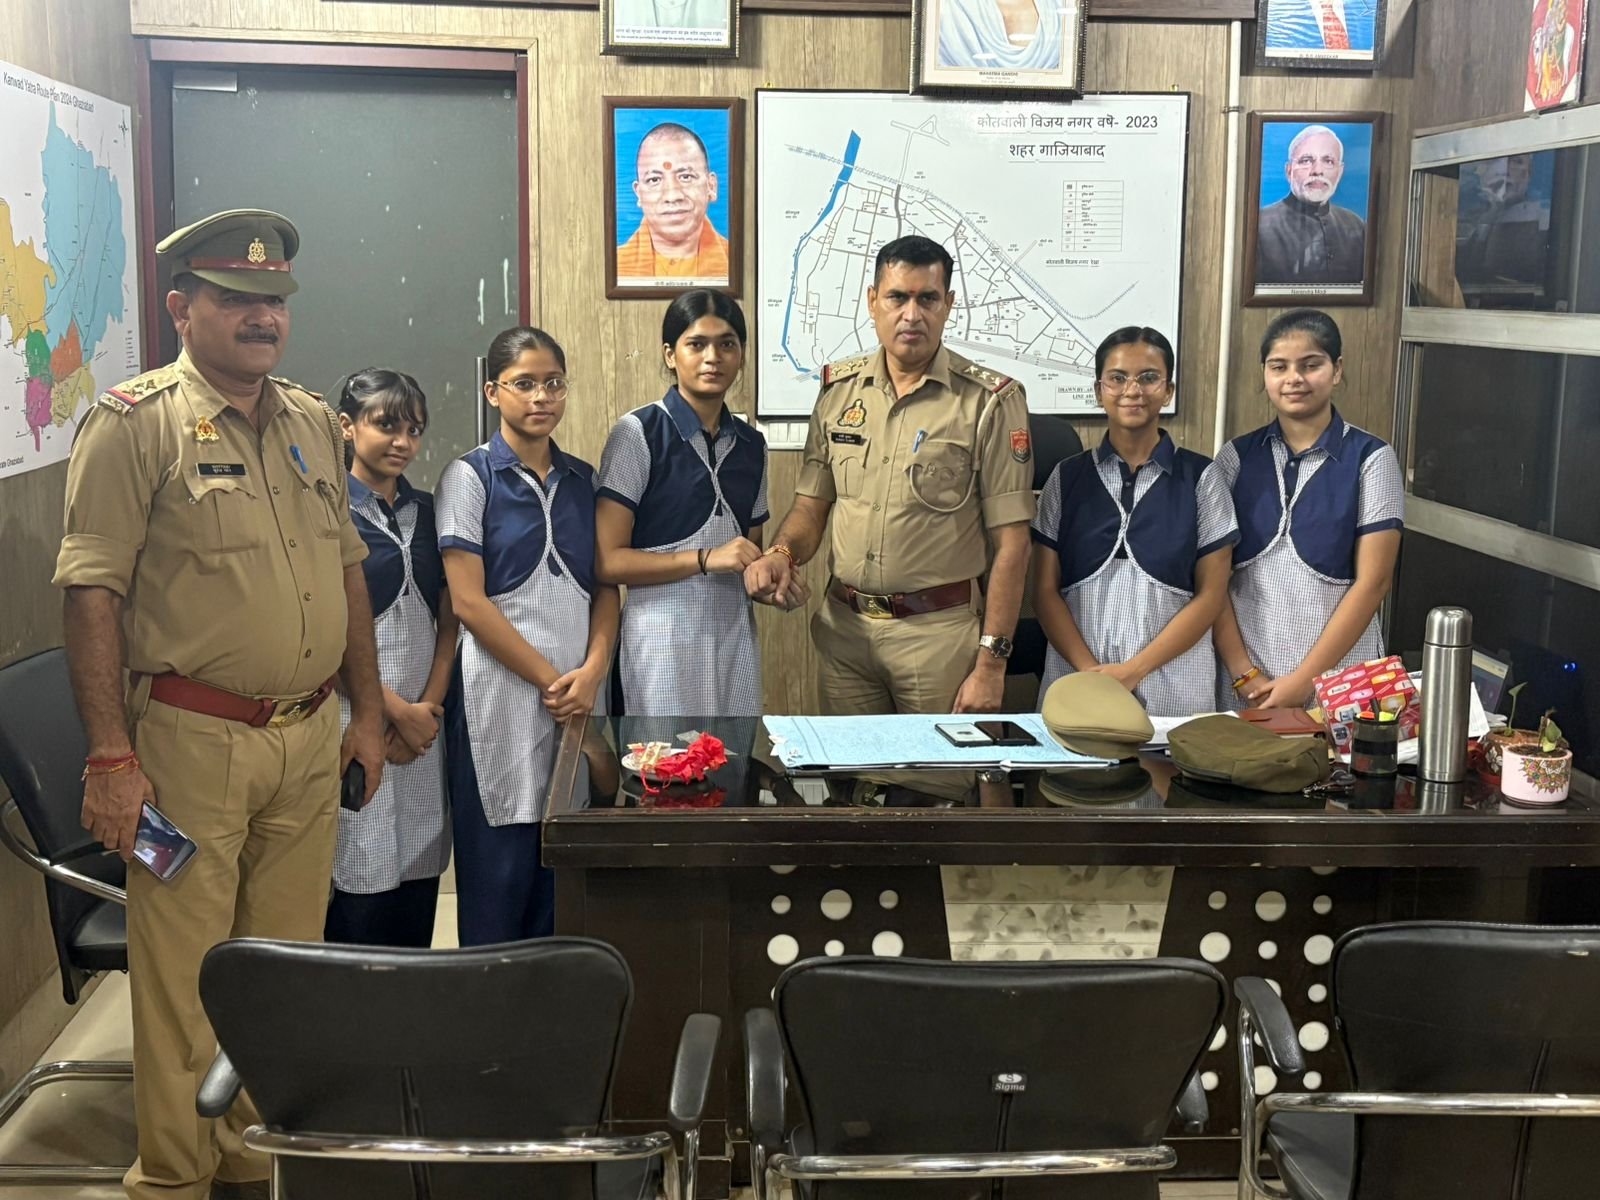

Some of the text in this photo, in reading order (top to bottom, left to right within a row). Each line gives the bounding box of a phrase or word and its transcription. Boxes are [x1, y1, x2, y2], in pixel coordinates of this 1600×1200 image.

[36, 83, 50, 98] Route
[977, 113, 1027, 128] कोतवाली
[1031, 113, 1064, 128] विजय
[1067, 116, 1094, 128] नगर
[1126, 115, 1158, 128] 2023
[1009, 140, 1106, 158] शहर गाजियाबाद
[995, 1083, 1025, 1092] Sigma
